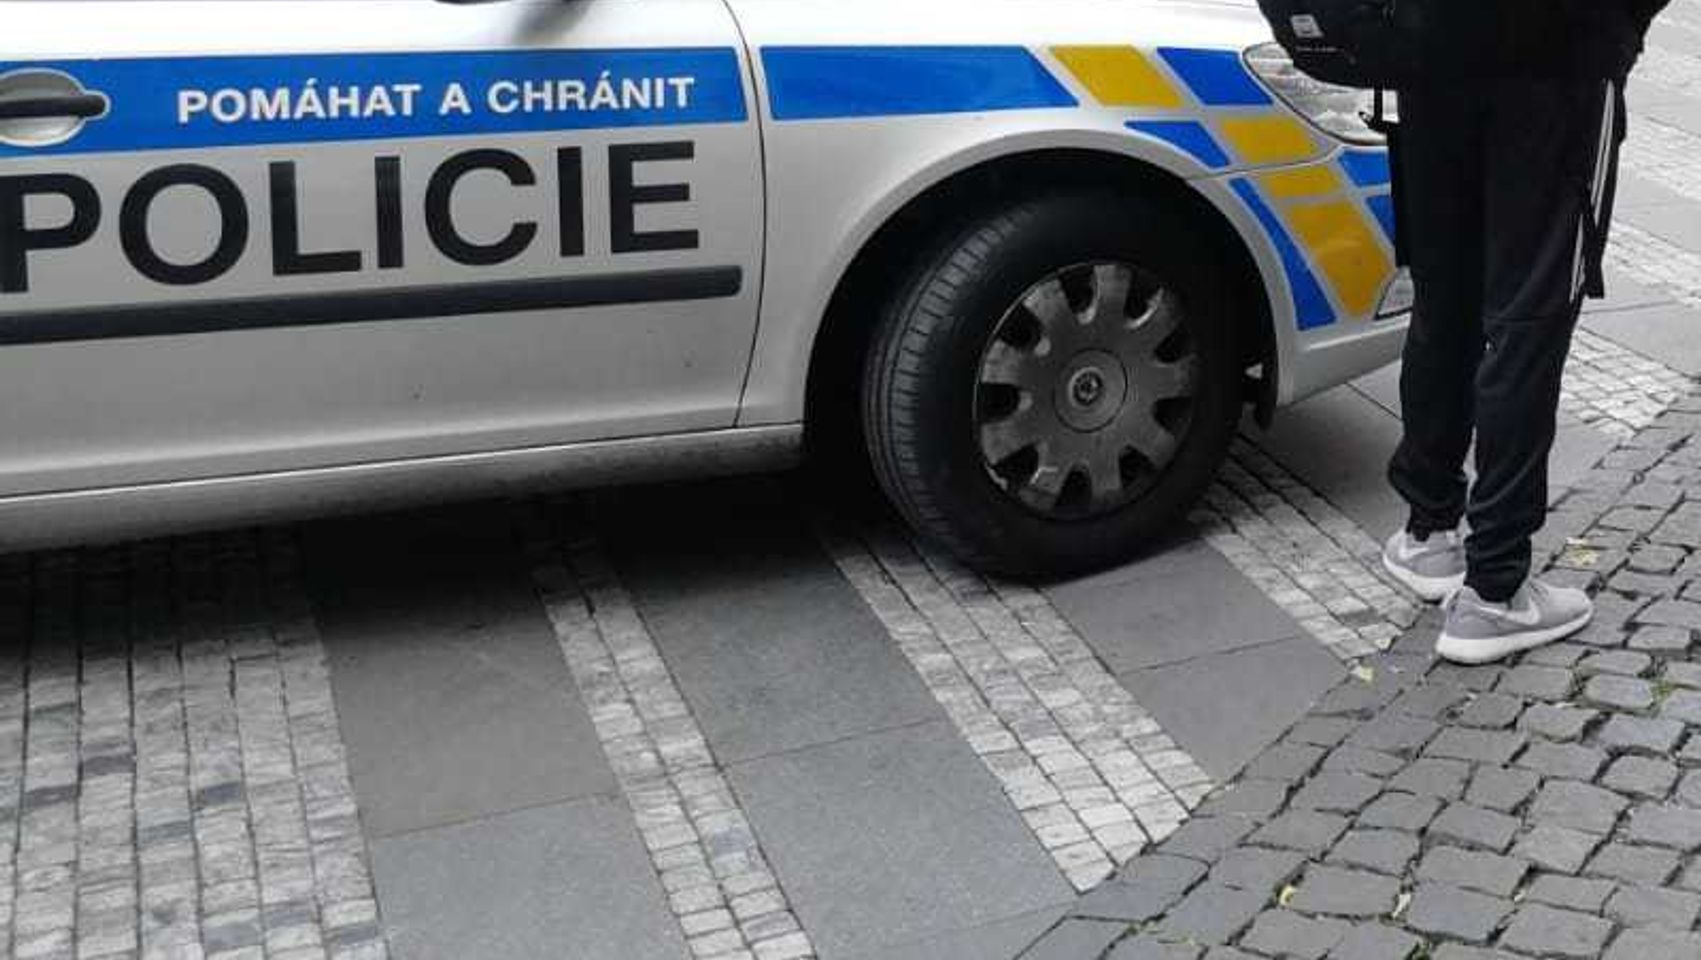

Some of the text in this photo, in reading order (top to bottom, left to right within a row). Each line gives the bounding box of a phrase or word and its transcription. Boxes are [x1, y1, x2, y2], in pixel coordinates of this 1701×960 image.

[177, 69, 696, 124] POMÁHAT A CHRÁNIT
[0, 140, 700, 294] POLICIE
